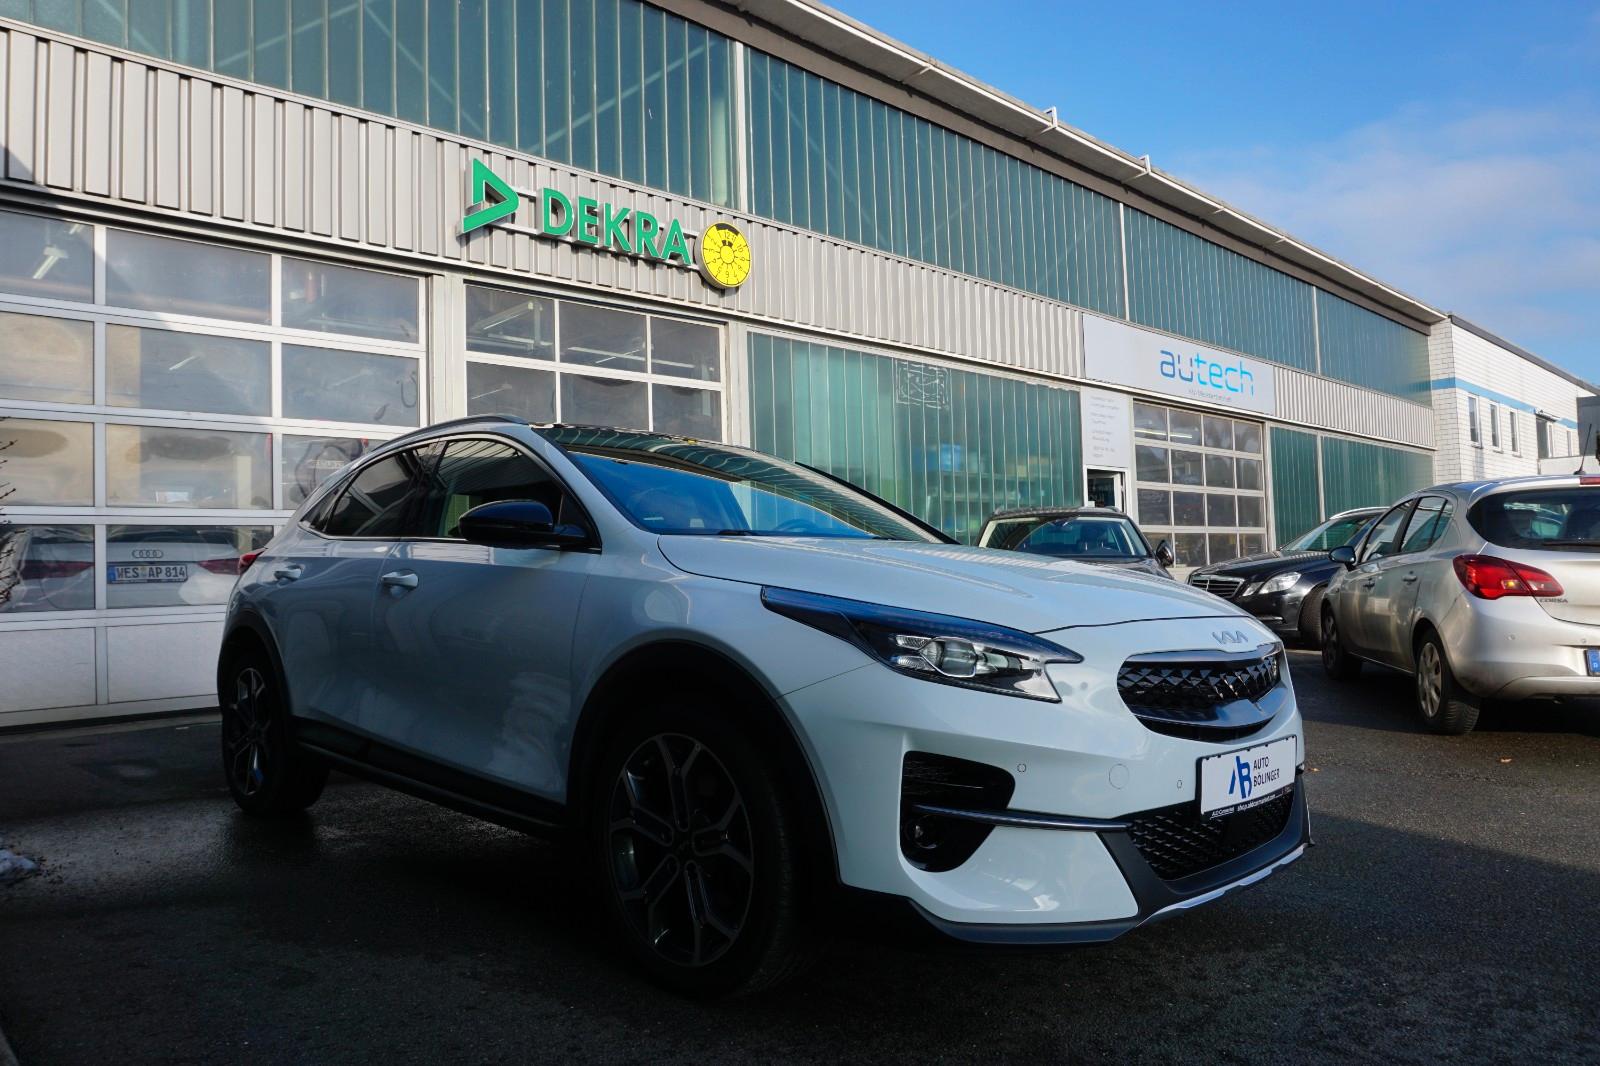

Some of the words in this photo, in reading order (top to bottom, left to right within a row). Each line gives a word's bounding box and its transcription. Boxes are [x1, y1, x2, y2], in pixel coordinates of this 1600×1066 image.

[537, 187, 692, 266] DEKRA
[724, 231, 731, 240] 12
[1160, 350, 1254, 397] autech
[116, 566, 139, 579] WES
[148, 566, 162, 578] AP
[165, 566, 185, 578] 814
[1253, 756, 1270, 770] AUTO
[1253, 768, 1280, 787] BÖLINGER
